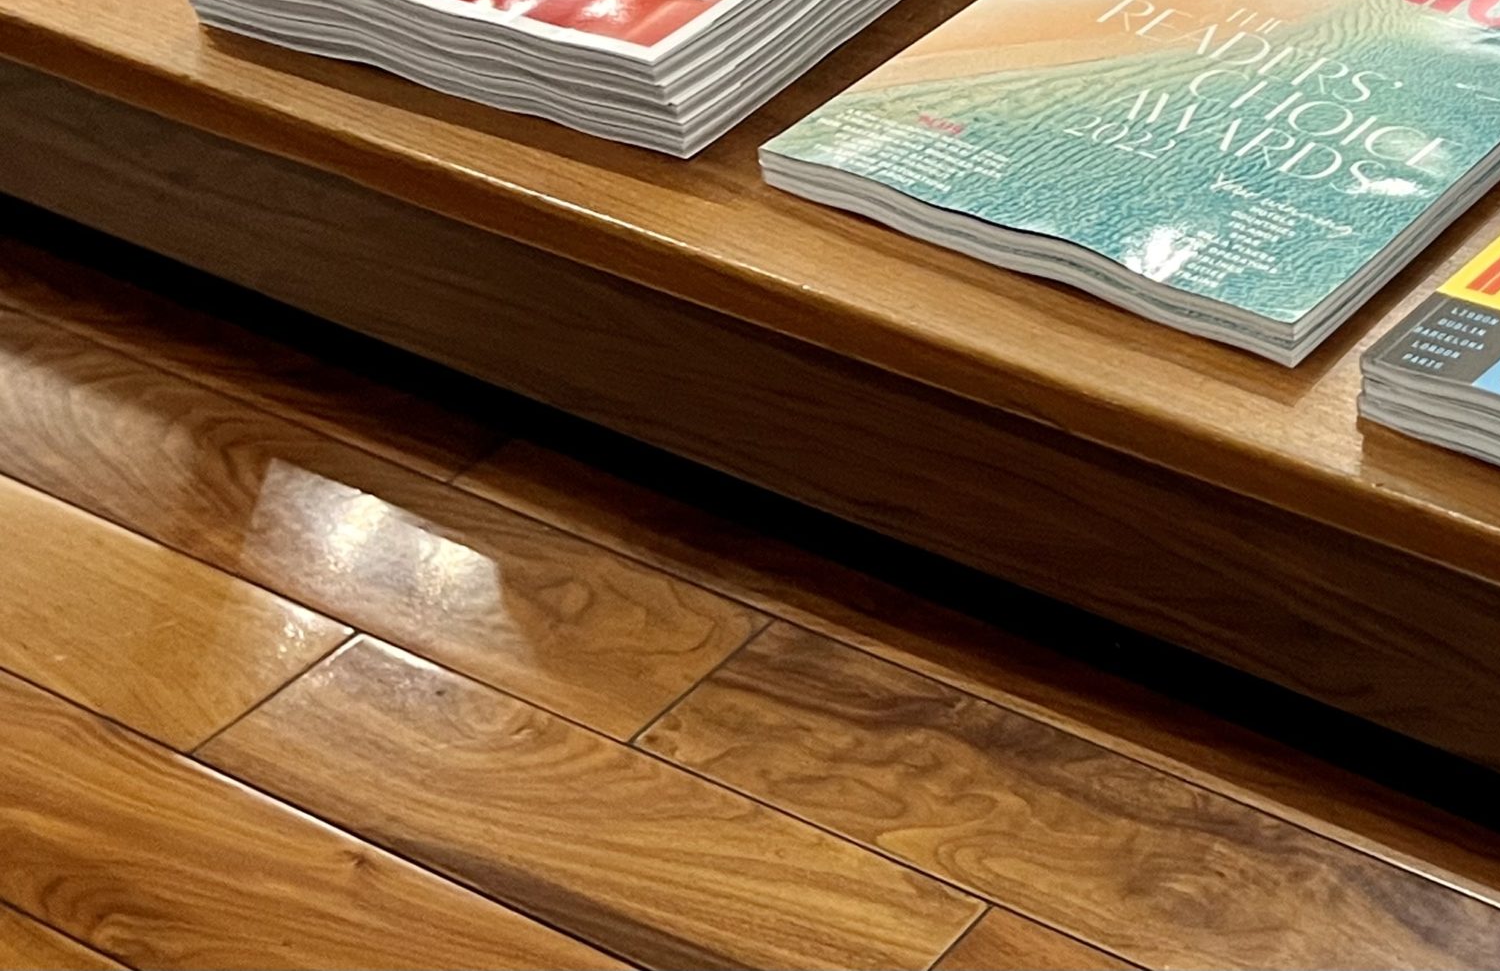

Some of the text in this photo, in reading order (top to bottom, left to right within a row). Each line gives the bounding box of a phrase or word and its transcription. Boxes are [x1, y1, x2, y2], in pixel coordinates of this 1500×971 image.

[1189, 68, 1464, 177] CHOICE
[1063, 115, 1176, 160] 2022
[1108, 88, 1388, 197] AWARDS
[1209, 172, 1354, 238] Your winning
[1249, 206, 1296, 226] HOTELS
[1231, 210, 1297, 237] COUNTRIES
[1437, 317, 1486, 335] DUBLIN
[1451, 308, 1498, 325] LISBON
[1413, 326, 1484, 349] BARCELONA
[1402, 353, 1443, 369] PARIS
[1412, 341, 1460, 358] LONDON
